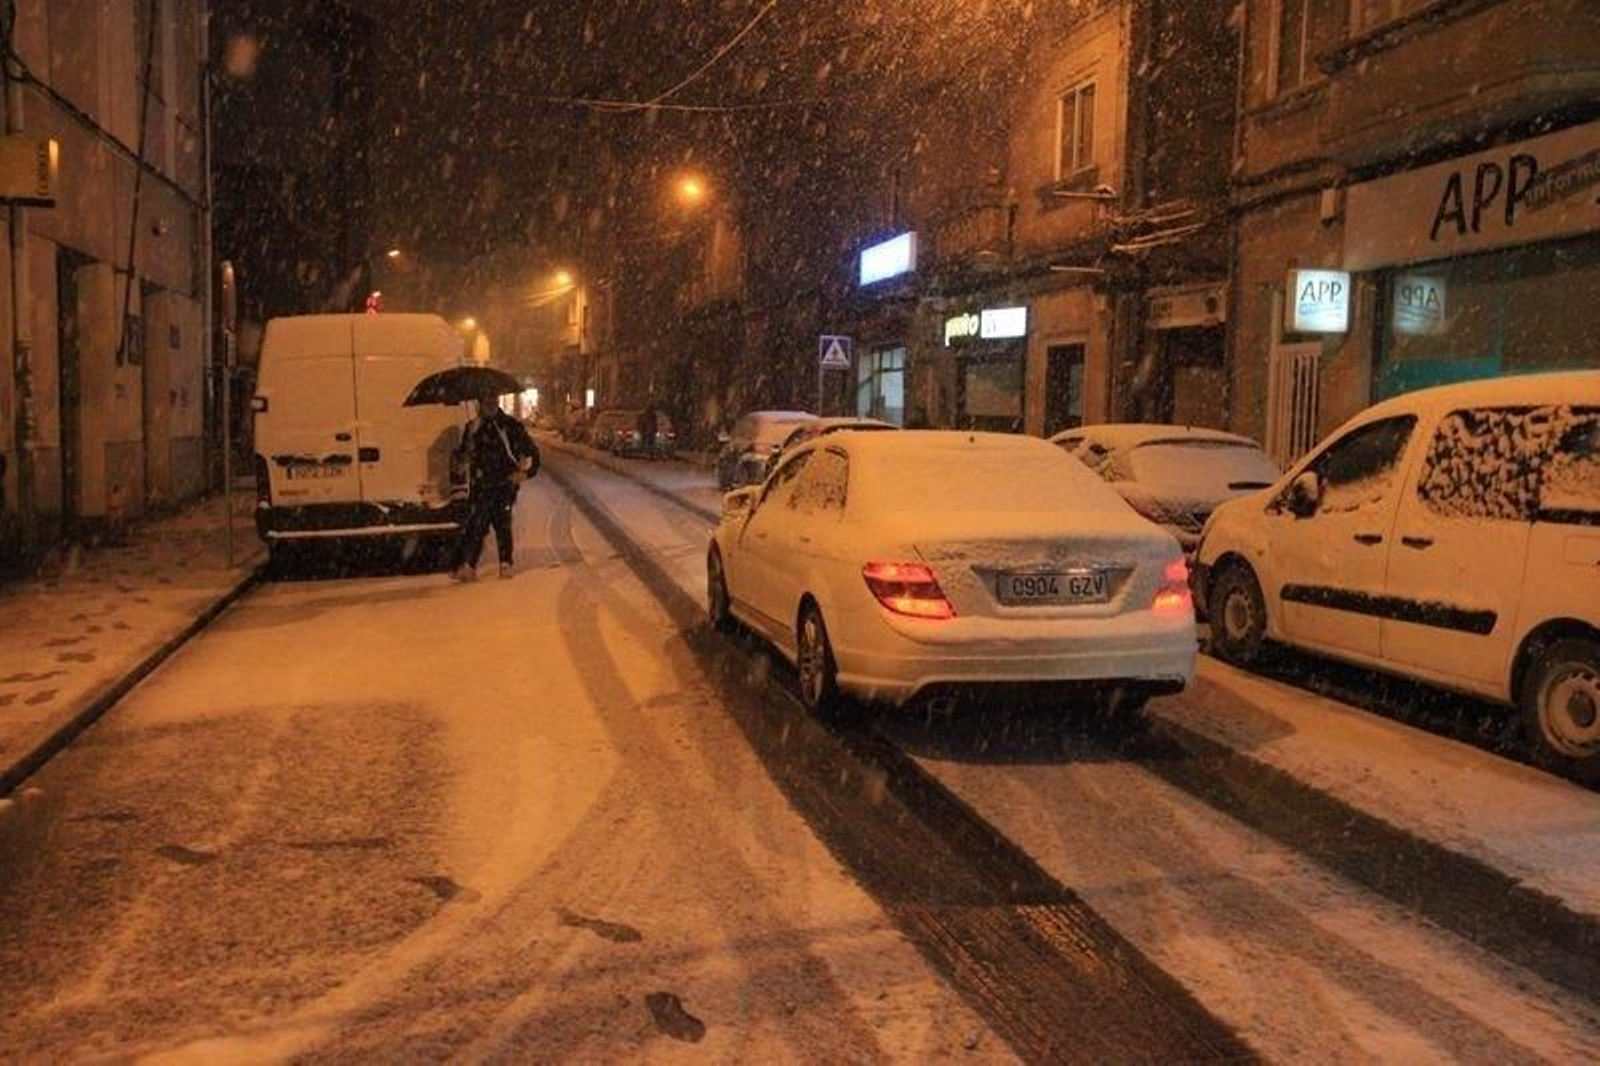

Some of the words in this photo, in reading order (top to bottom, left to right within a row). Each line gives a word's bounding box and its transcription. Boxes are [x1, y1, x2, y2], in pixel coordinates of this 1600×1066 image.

[1429, 153, 1537, 241] APP
[1301, 280, 1342, 302] APP
[1012, 576, 1058, 596] 0904
[1069, 574, 1104, 595] GZV
